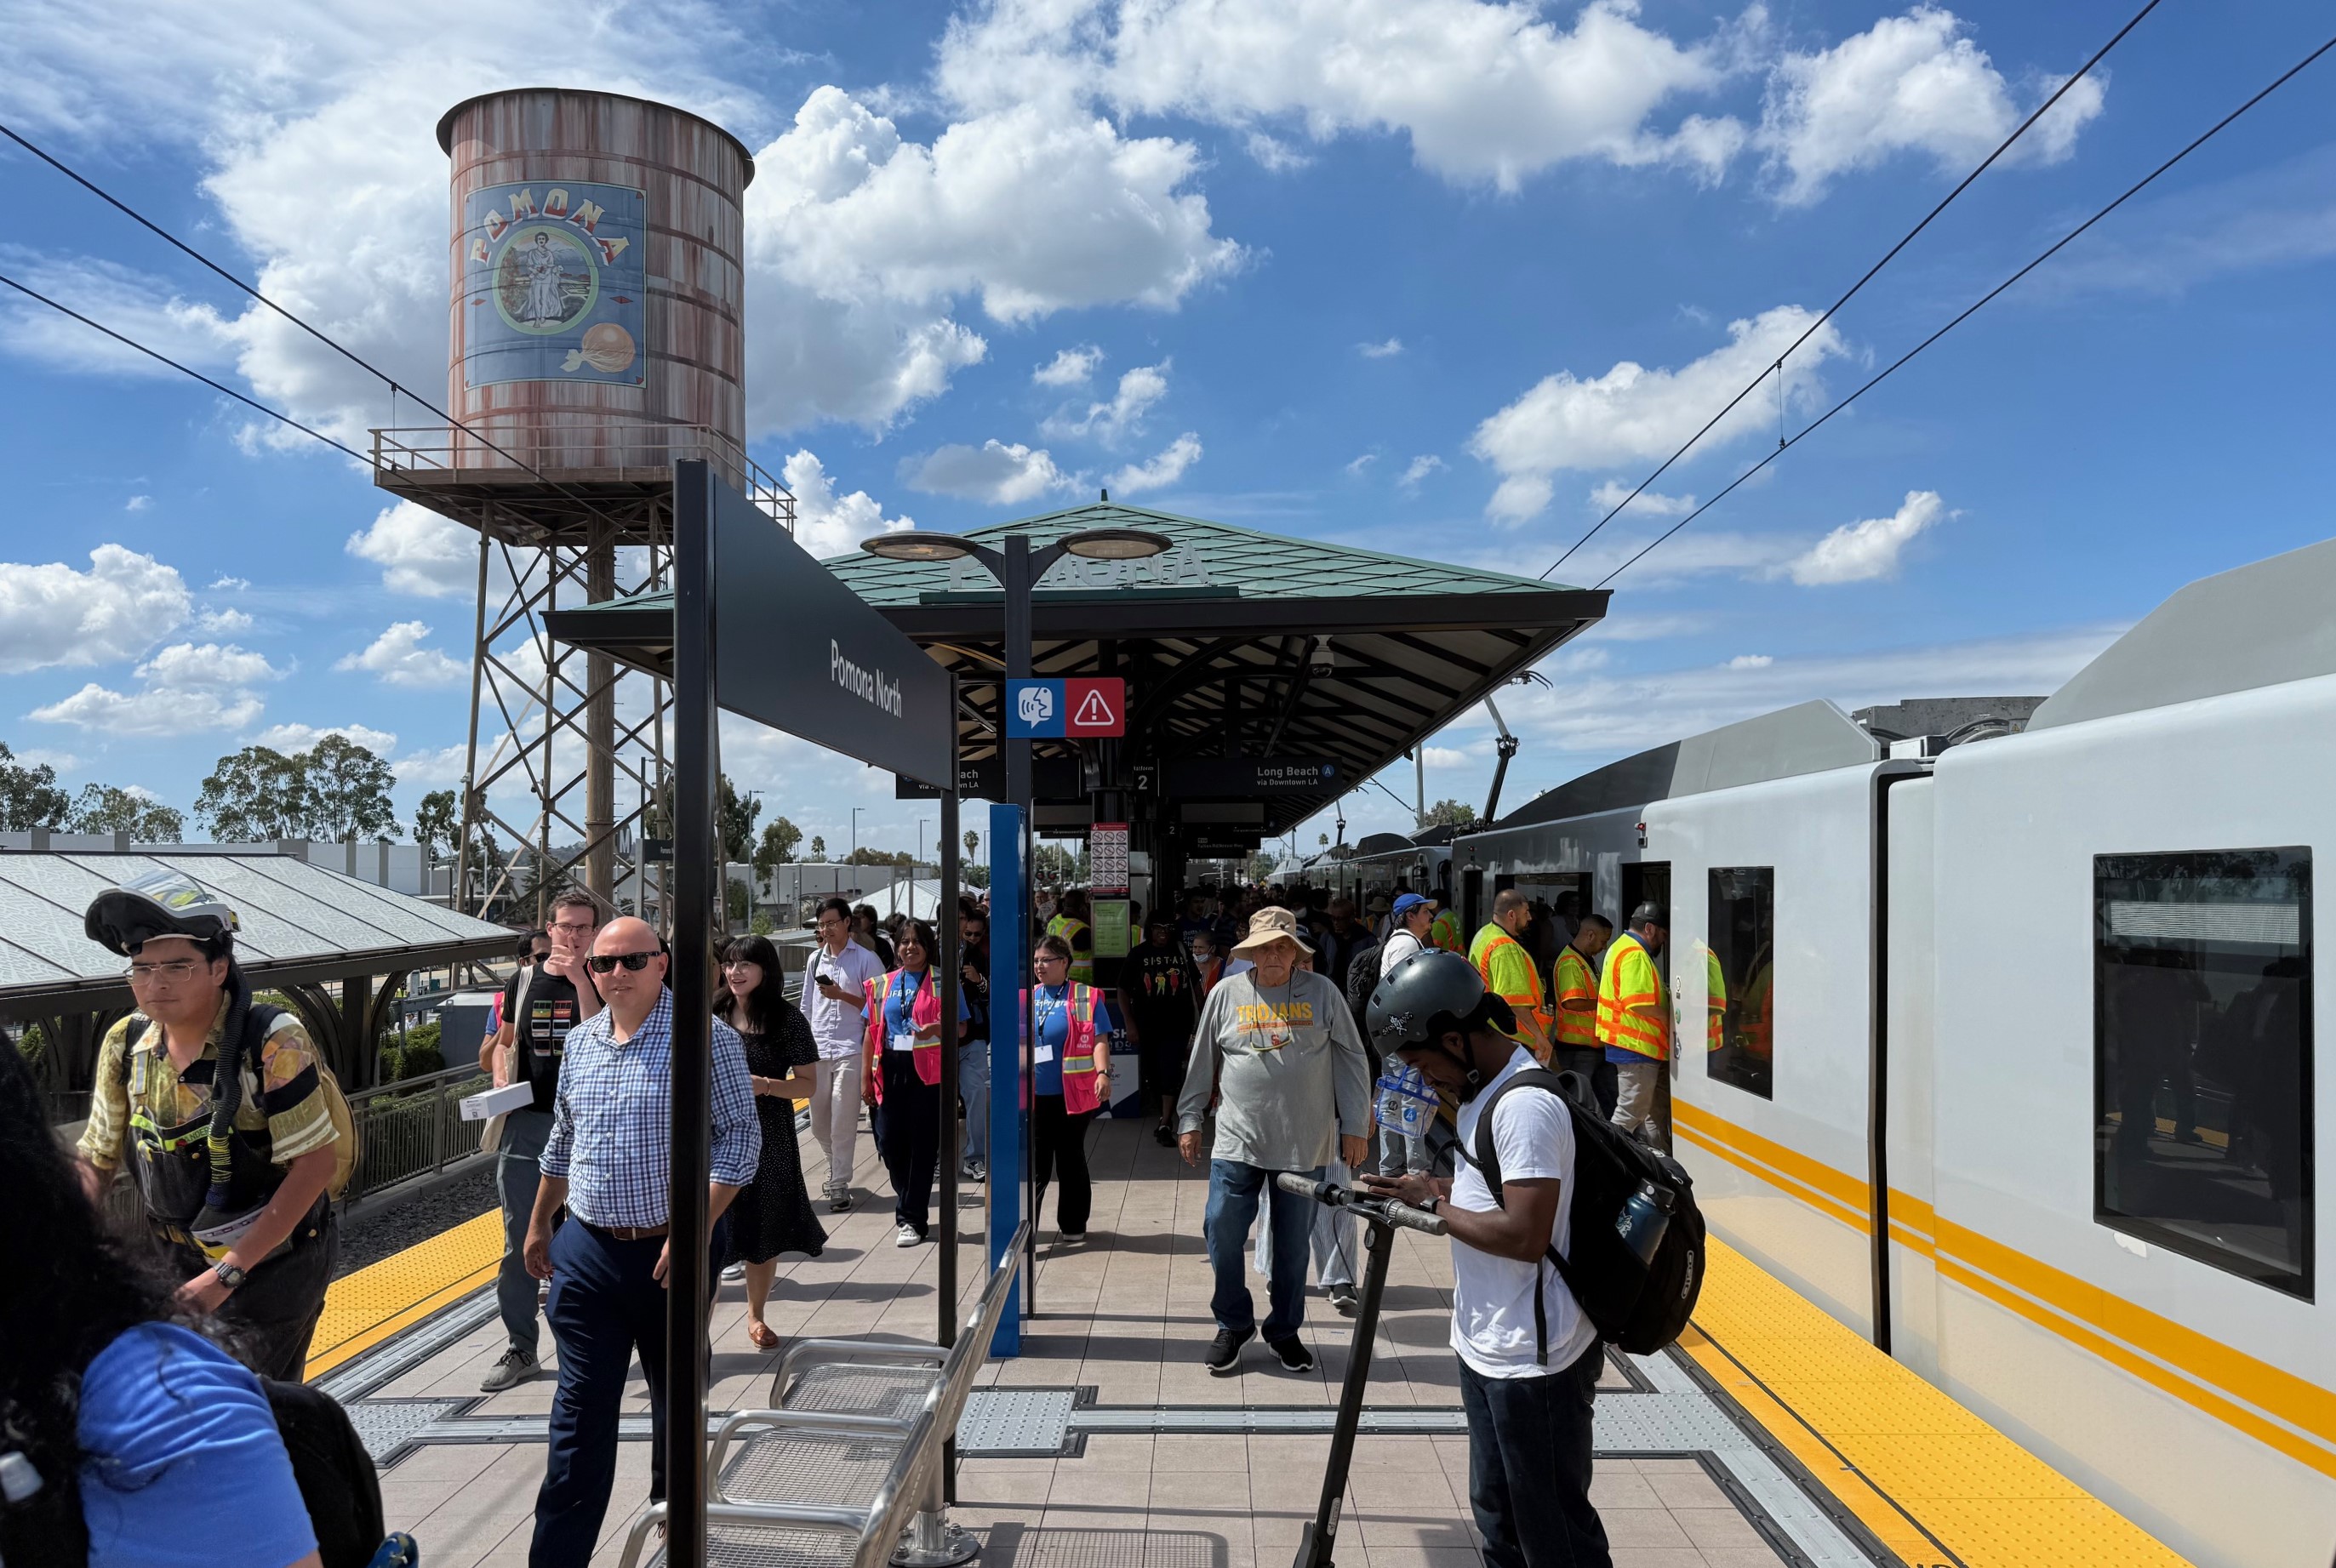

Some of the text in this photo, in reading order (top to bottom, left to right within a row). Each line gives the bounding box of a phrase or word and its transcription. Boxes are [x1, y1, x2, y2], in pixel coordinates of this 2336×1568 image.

[470, 188, 631, 267] POMONA
[831, 638, 902, 719] Pomona North
[1138, 774, 1148, 790] 2
[1257, 767, 1283, 778] Long
[1286, 766, 1318, 776] Beach
[619, 828, 631, 853] M
[1168, 826, 1175, 835] 2
[1237, 1001, 1312, 1022] TROJANS
